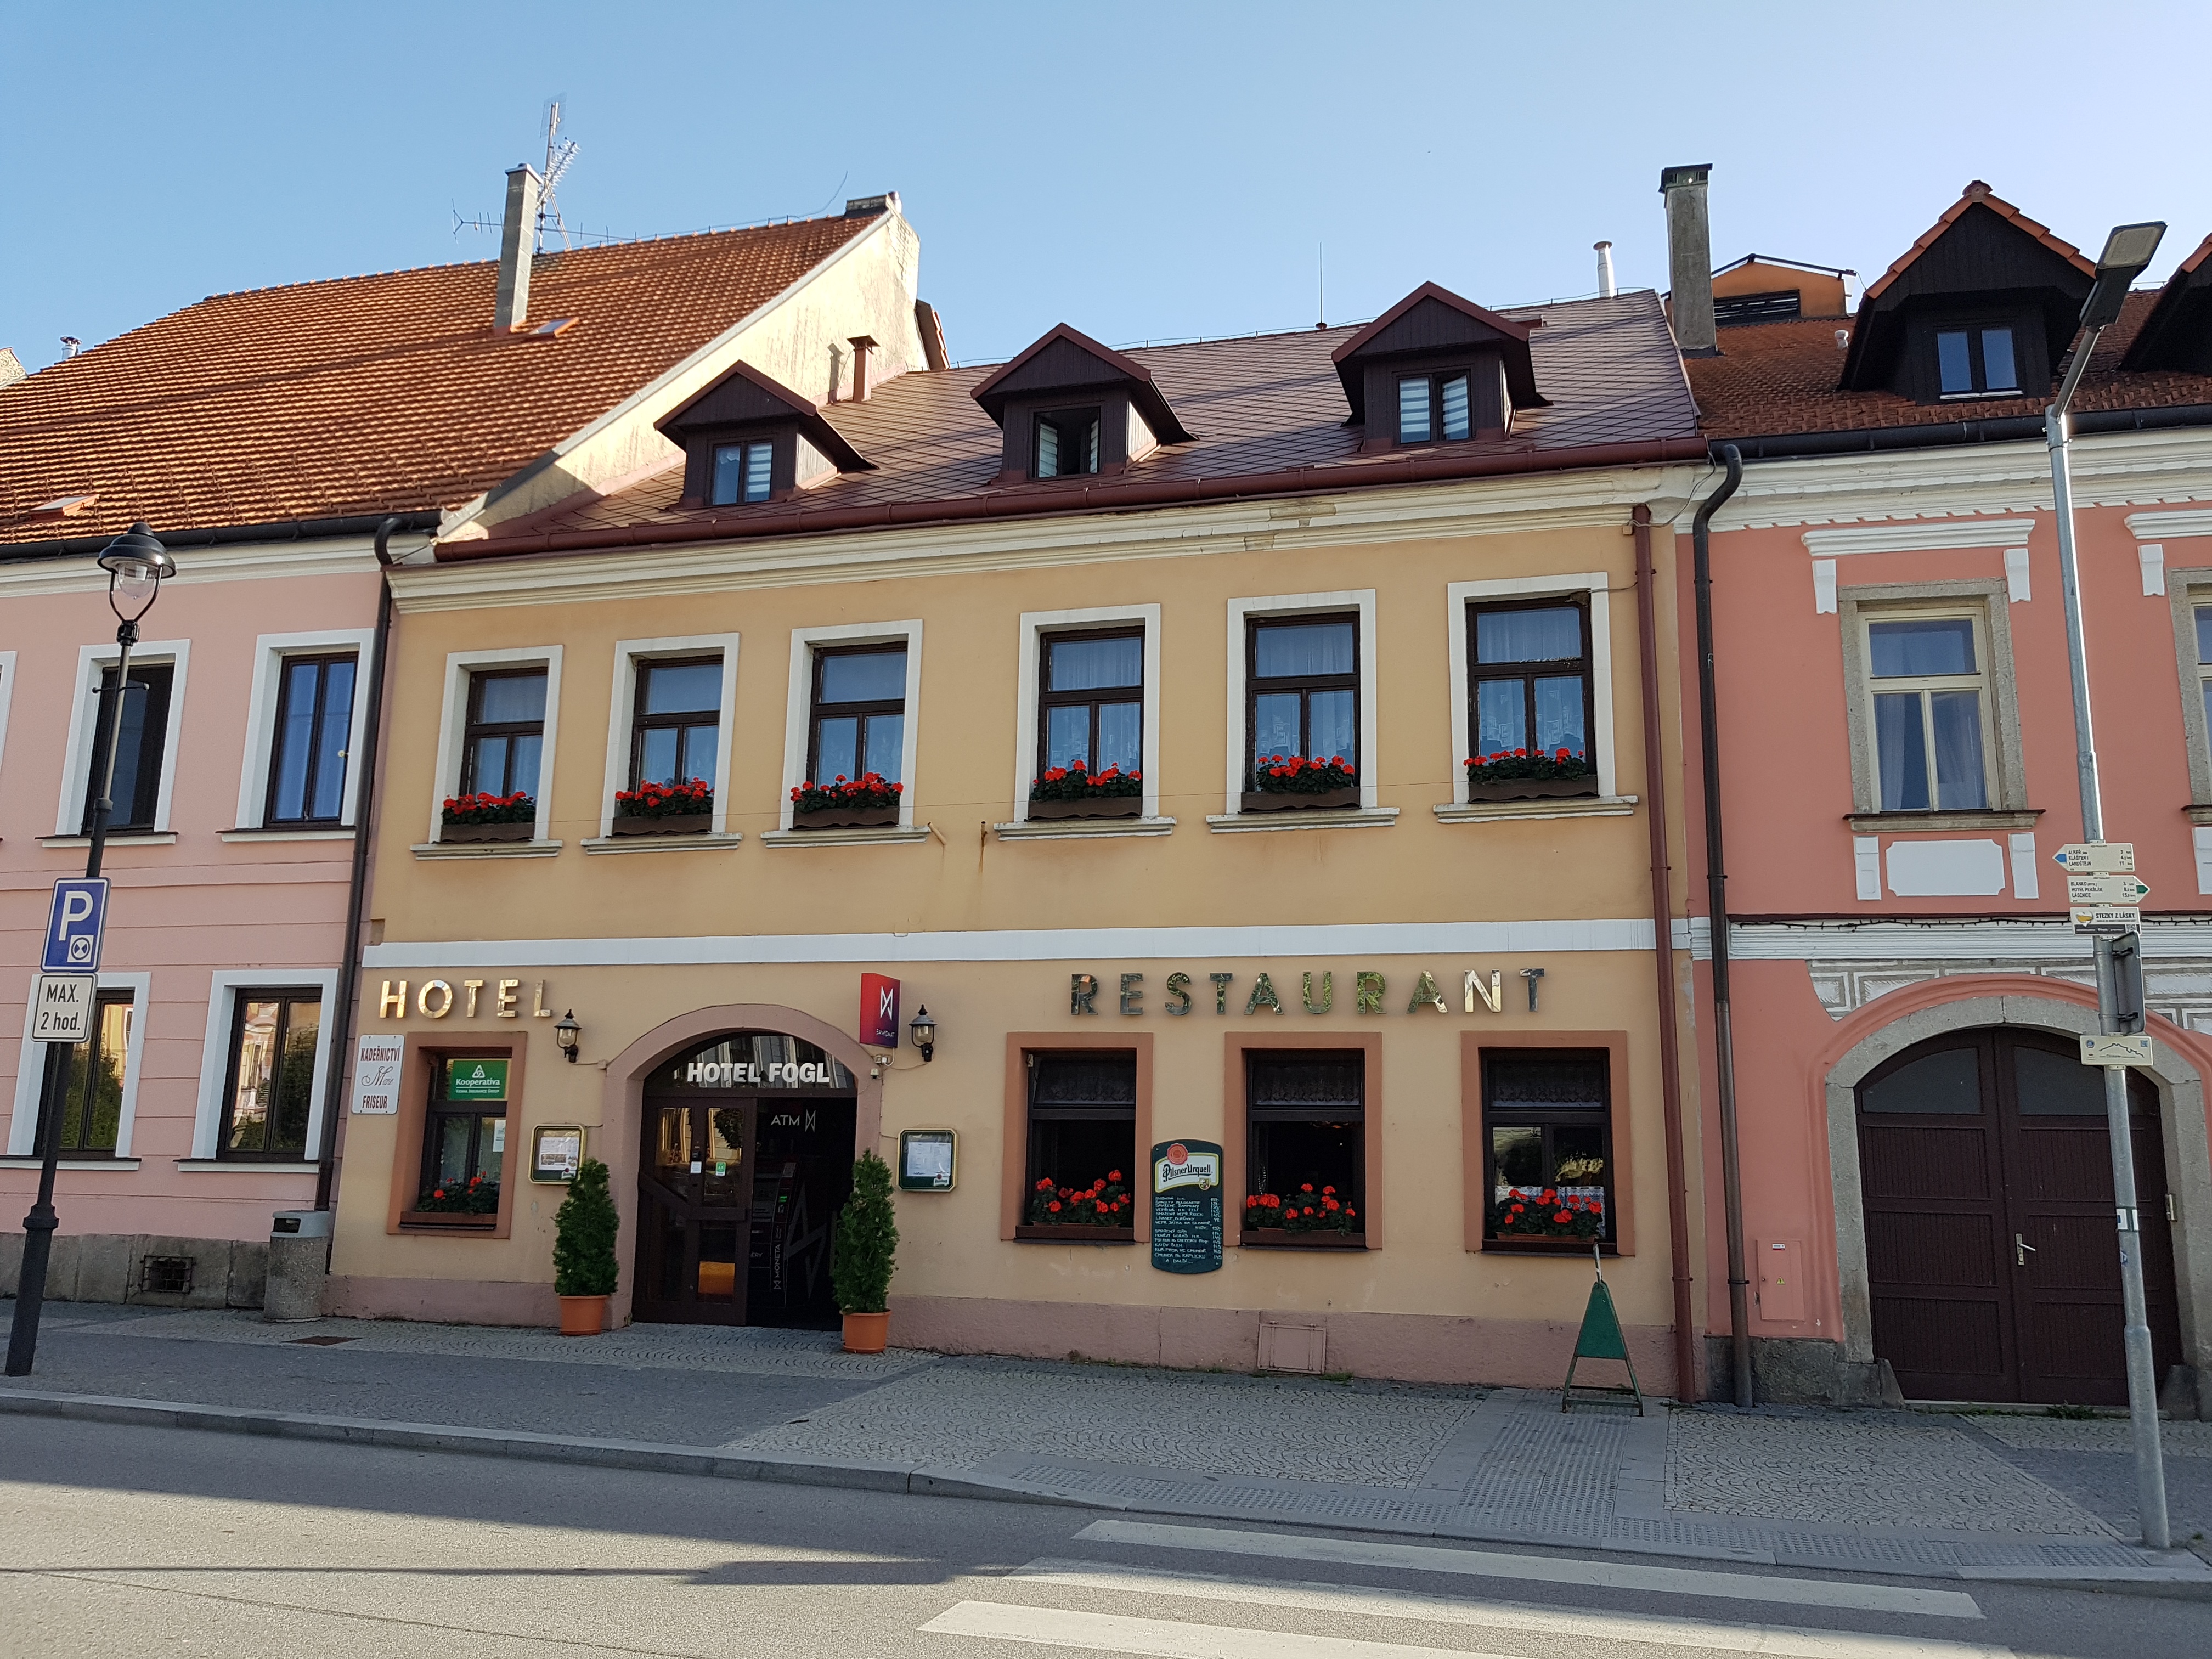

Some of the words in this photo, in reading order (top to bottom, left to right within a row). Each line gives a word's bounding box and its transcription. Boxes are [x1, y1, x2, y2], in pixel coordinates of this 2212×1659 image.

[58, 890, 94, 941] P
[46, 984, 79, 1002] MAX.
[380, 979, 552, 1019] HOTEL
[1070, 968, 1545, 1015] RESTAURANT
[41, 1012, 49, 1030] 2
[53, 1012, 81, 1030] hod.
[360, 1045, 402, 1062] KADEŘNICTVÍ
[687, 1063, 761, 1082] HOTEL
[769, 1063, 830, 1082] FOGL
[455, 1077, 500, 1087] Kooperativa
[362, 1095, 388, 1109] FRISEUR
[771, 1115, 800, 1126] ATM
[1163, 1164, 1187, 1182] Pilsner
